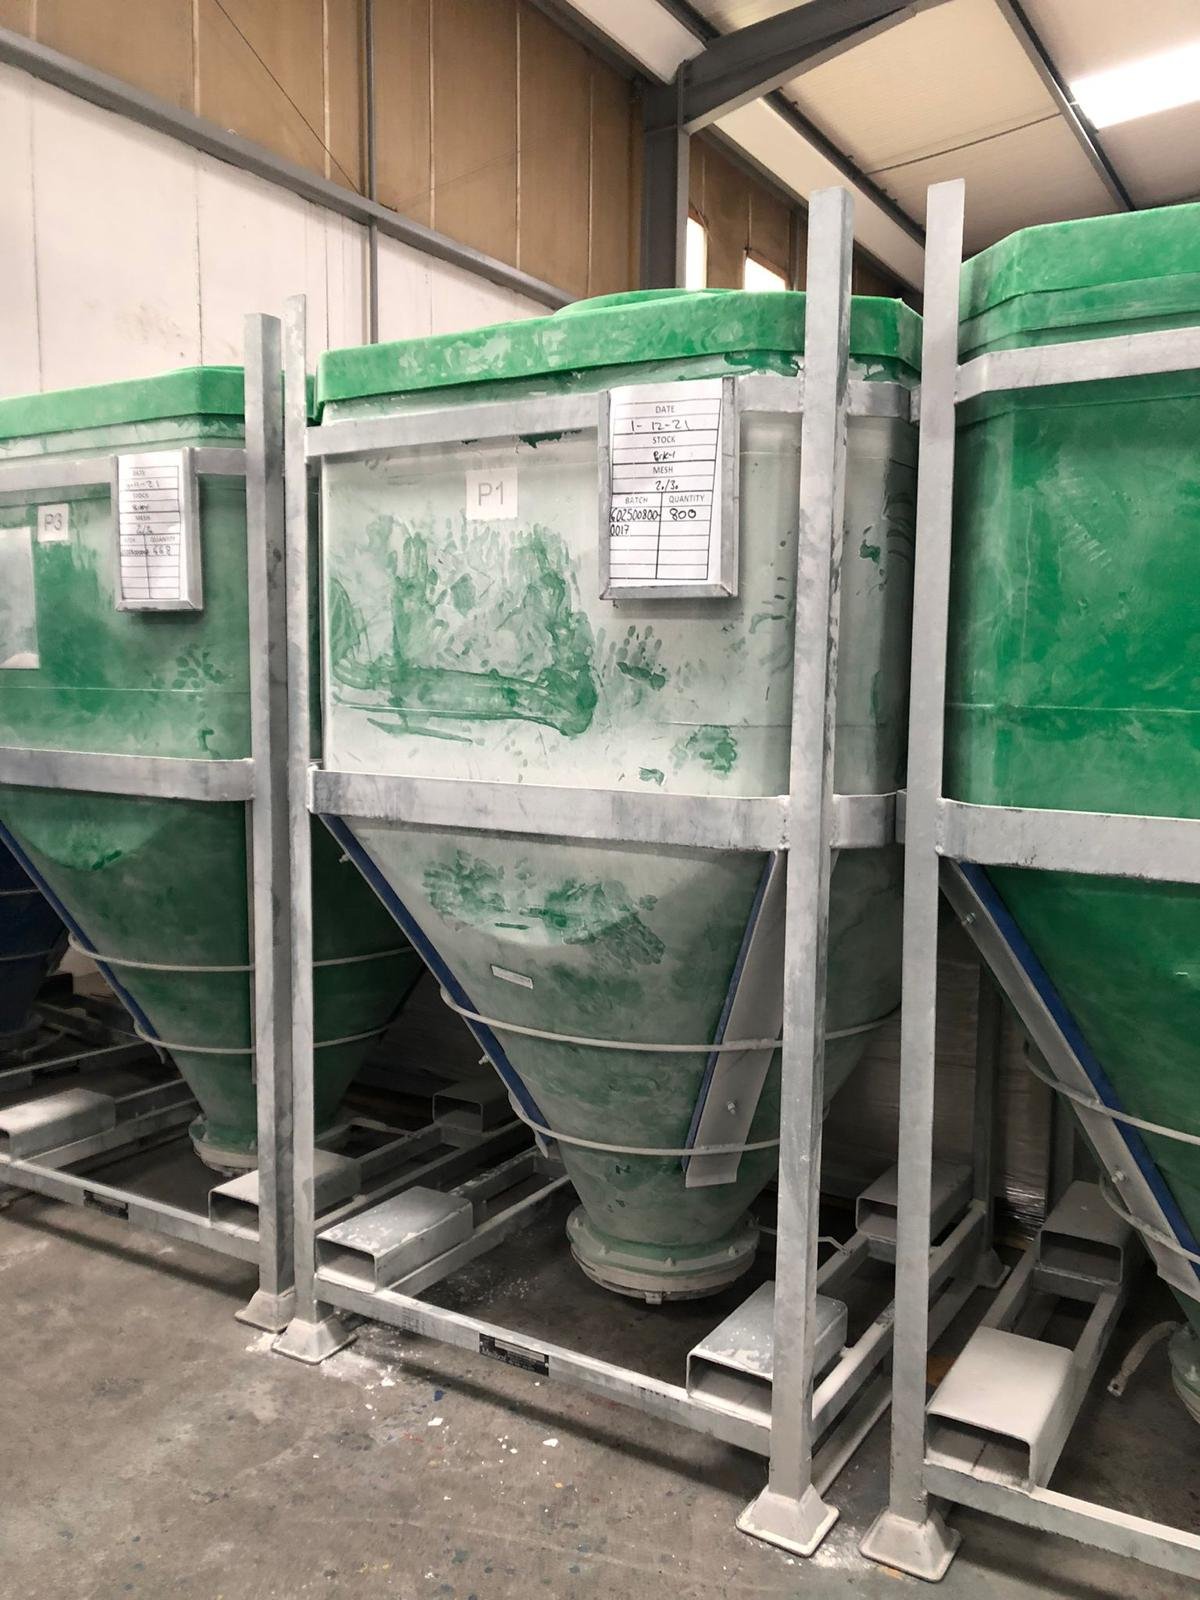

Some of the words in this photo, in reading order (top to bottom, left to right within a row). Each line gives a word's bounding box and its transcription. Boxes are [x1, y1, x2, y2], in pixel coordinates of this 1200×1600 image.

[655, 405, 675, 414] DATE
[652, 435, 676, 445] STOCK
[652, 466, 674, 474] MESH
[478, 480, 504, 506] P1
[624, 496, 649, 505] BATCH
[668, 493, 706, 504] QUANTITY
[669, 507, 697, 521] 800
[44, 513, 64, 531] P3
